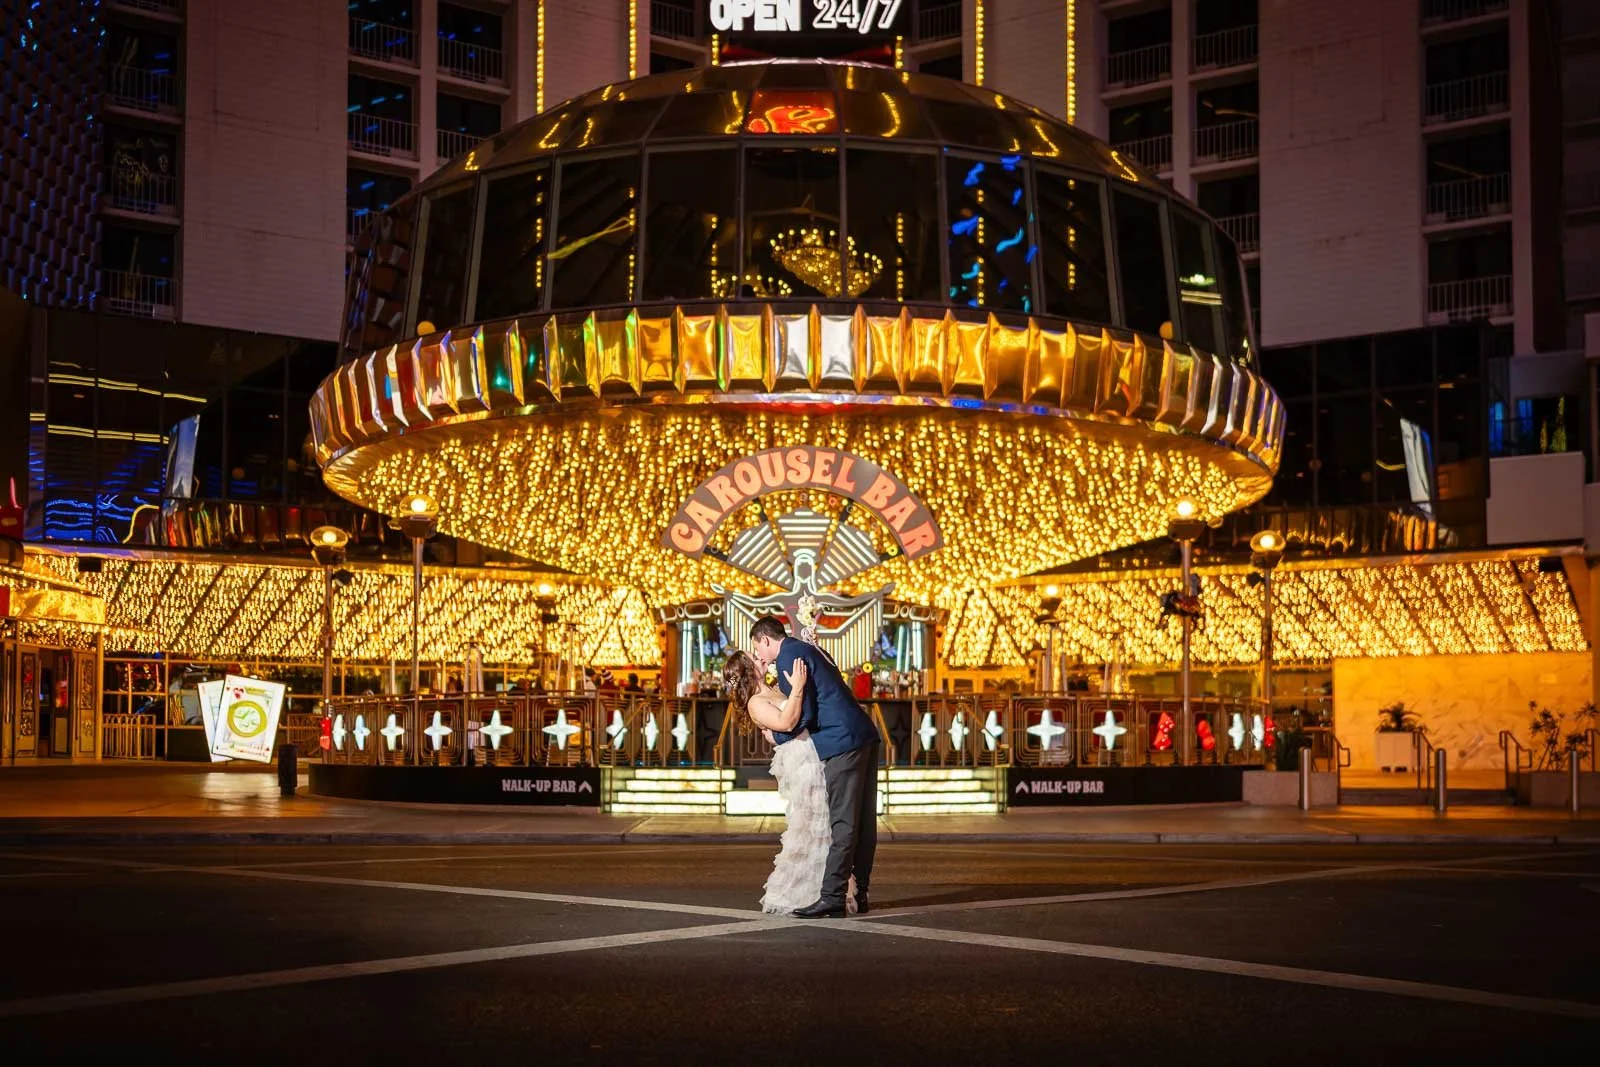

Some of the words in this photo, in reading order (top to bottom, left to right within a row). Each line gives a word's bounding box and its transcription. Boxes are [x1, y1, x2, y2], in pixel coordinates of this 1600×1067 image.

[709, 0, 800, 32] OPEN
[812, 0, 901, 35] 24/7
[670, 447, 857, 553] CAROUSEL
[860, 471, 938, 557] BAR
[501, 779, 552, 793] WALK-UP
[552, 779, 577, 793] BAR
[1030, 780, 1082, 794] WALK-UP
[1082, 780, 1105, 794] BAR
